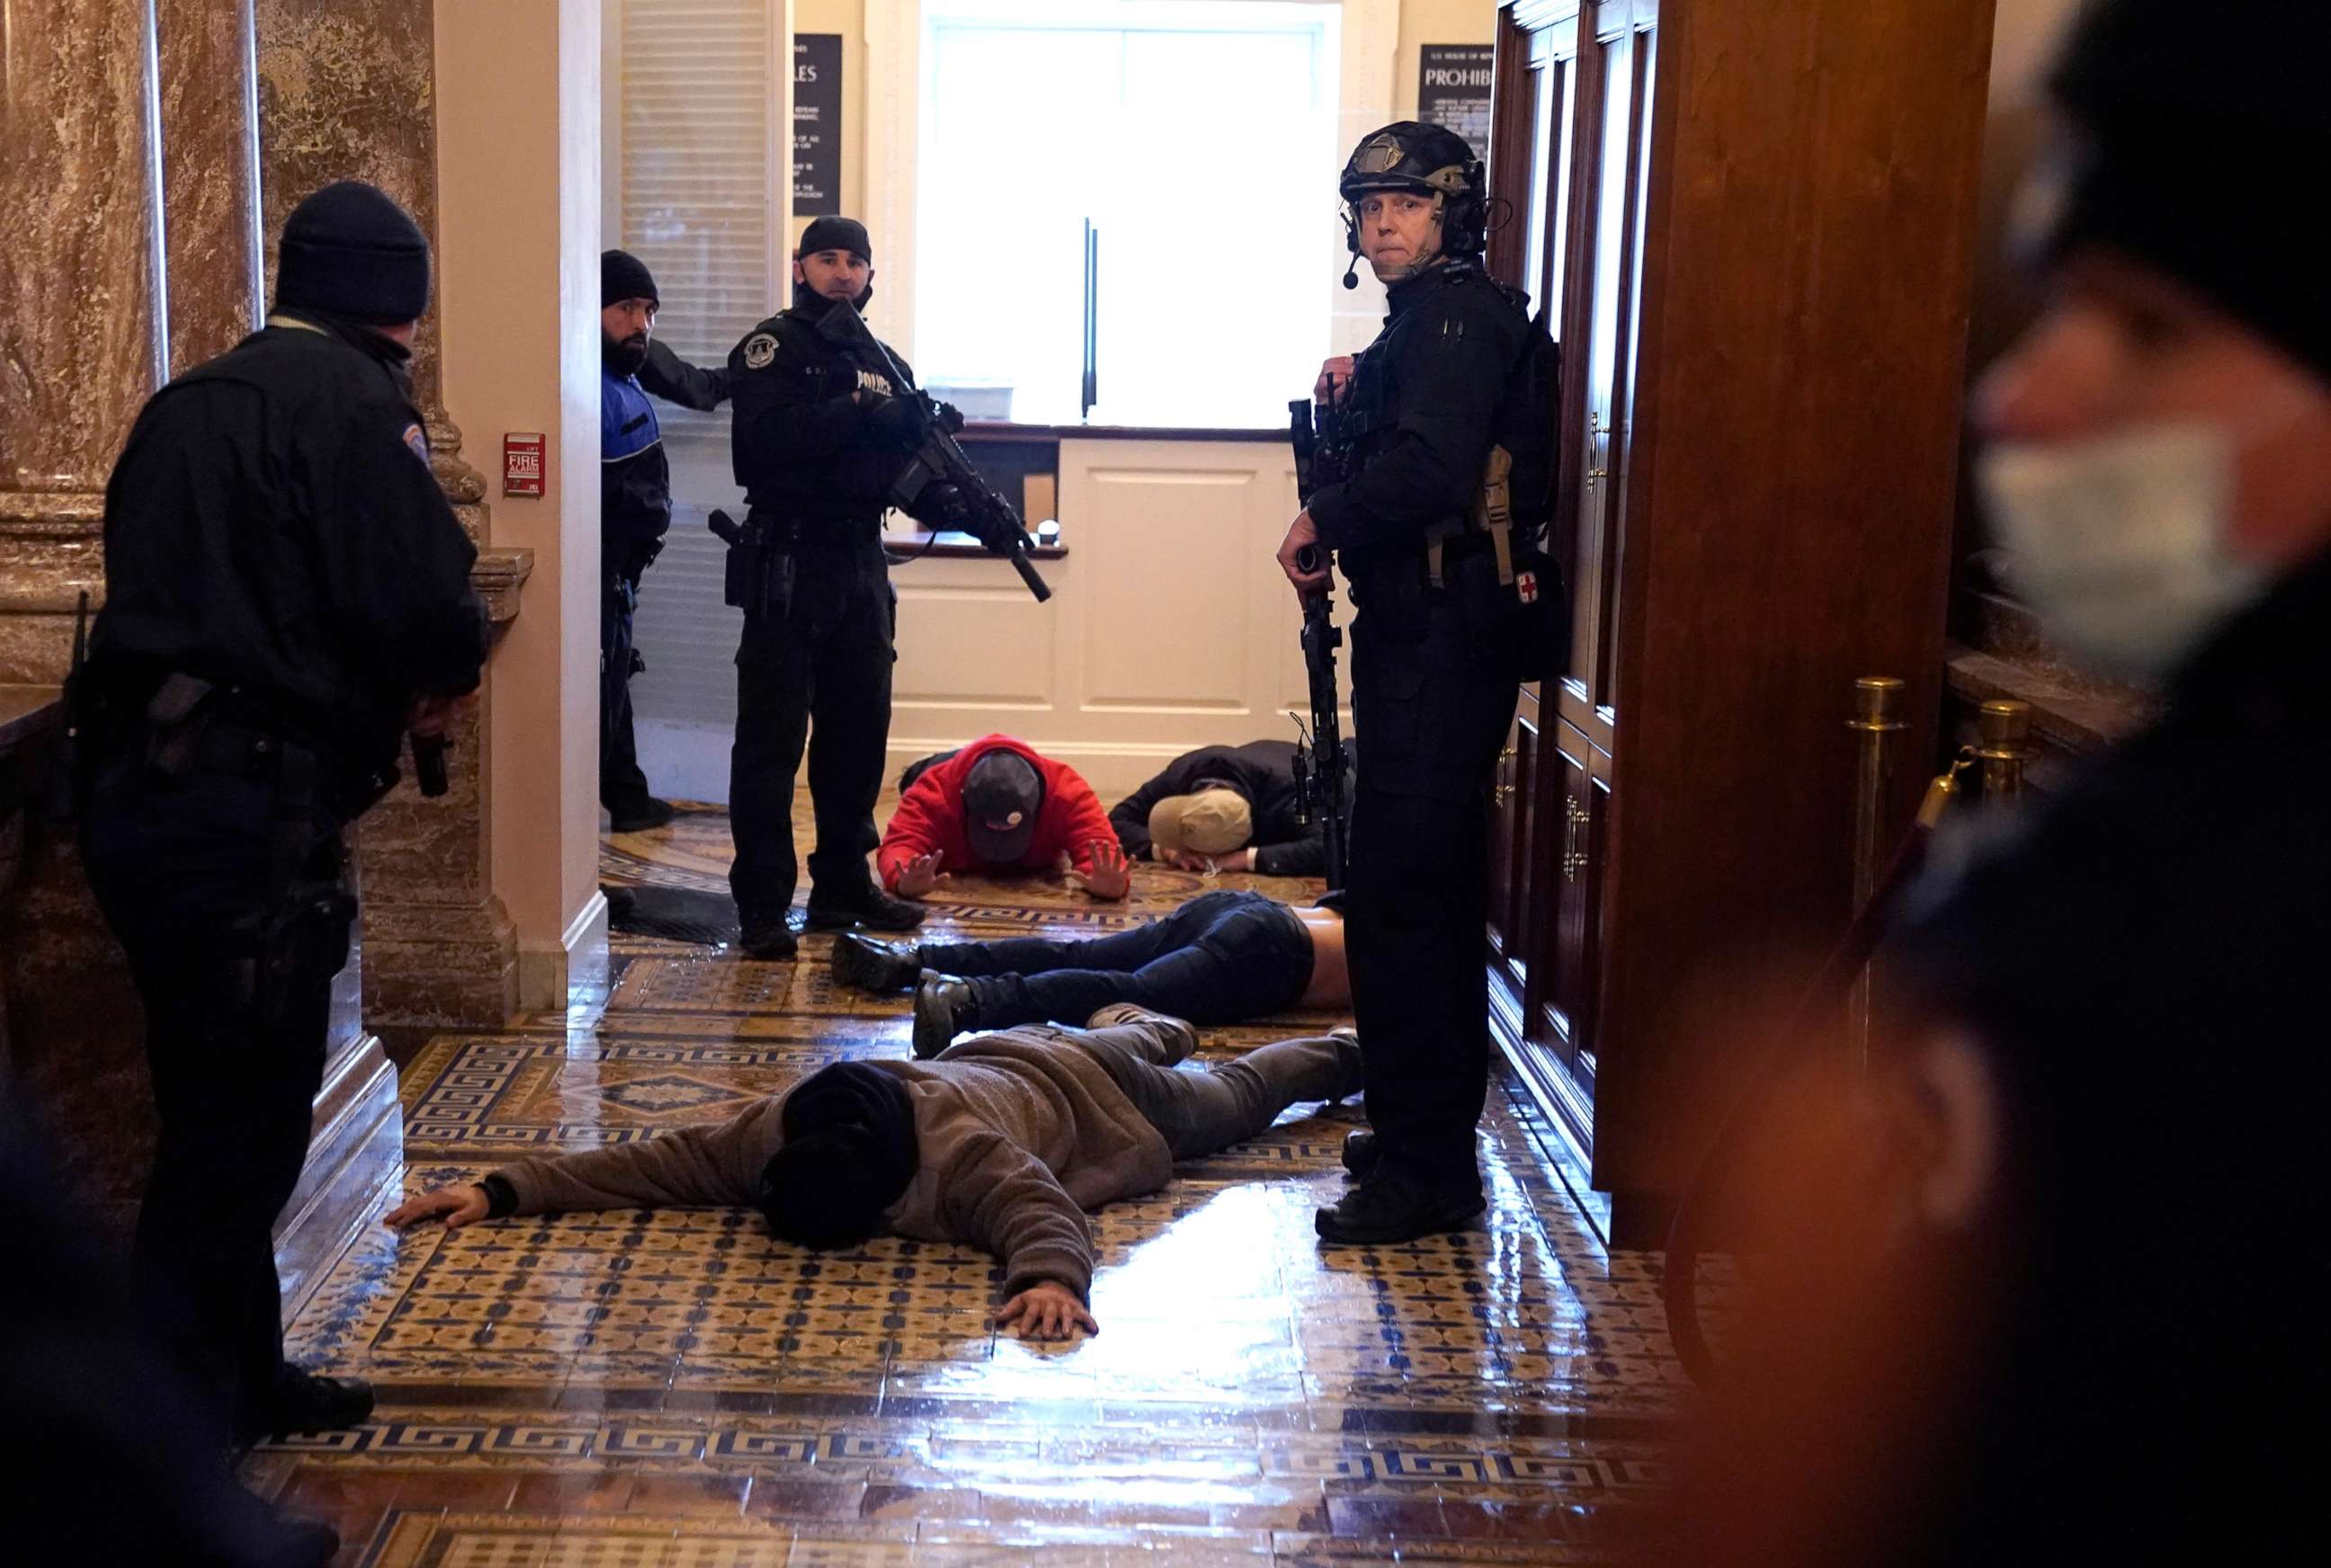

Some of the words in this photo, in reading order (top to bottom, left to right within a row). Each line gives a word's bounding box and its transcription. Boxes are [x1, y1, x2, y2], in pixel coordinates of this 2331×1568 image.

[1425, 69, 1491, 86] PROHIB
[857, 370, 892, 396] POLICE
[509, 455, 539, 466] FIRE
